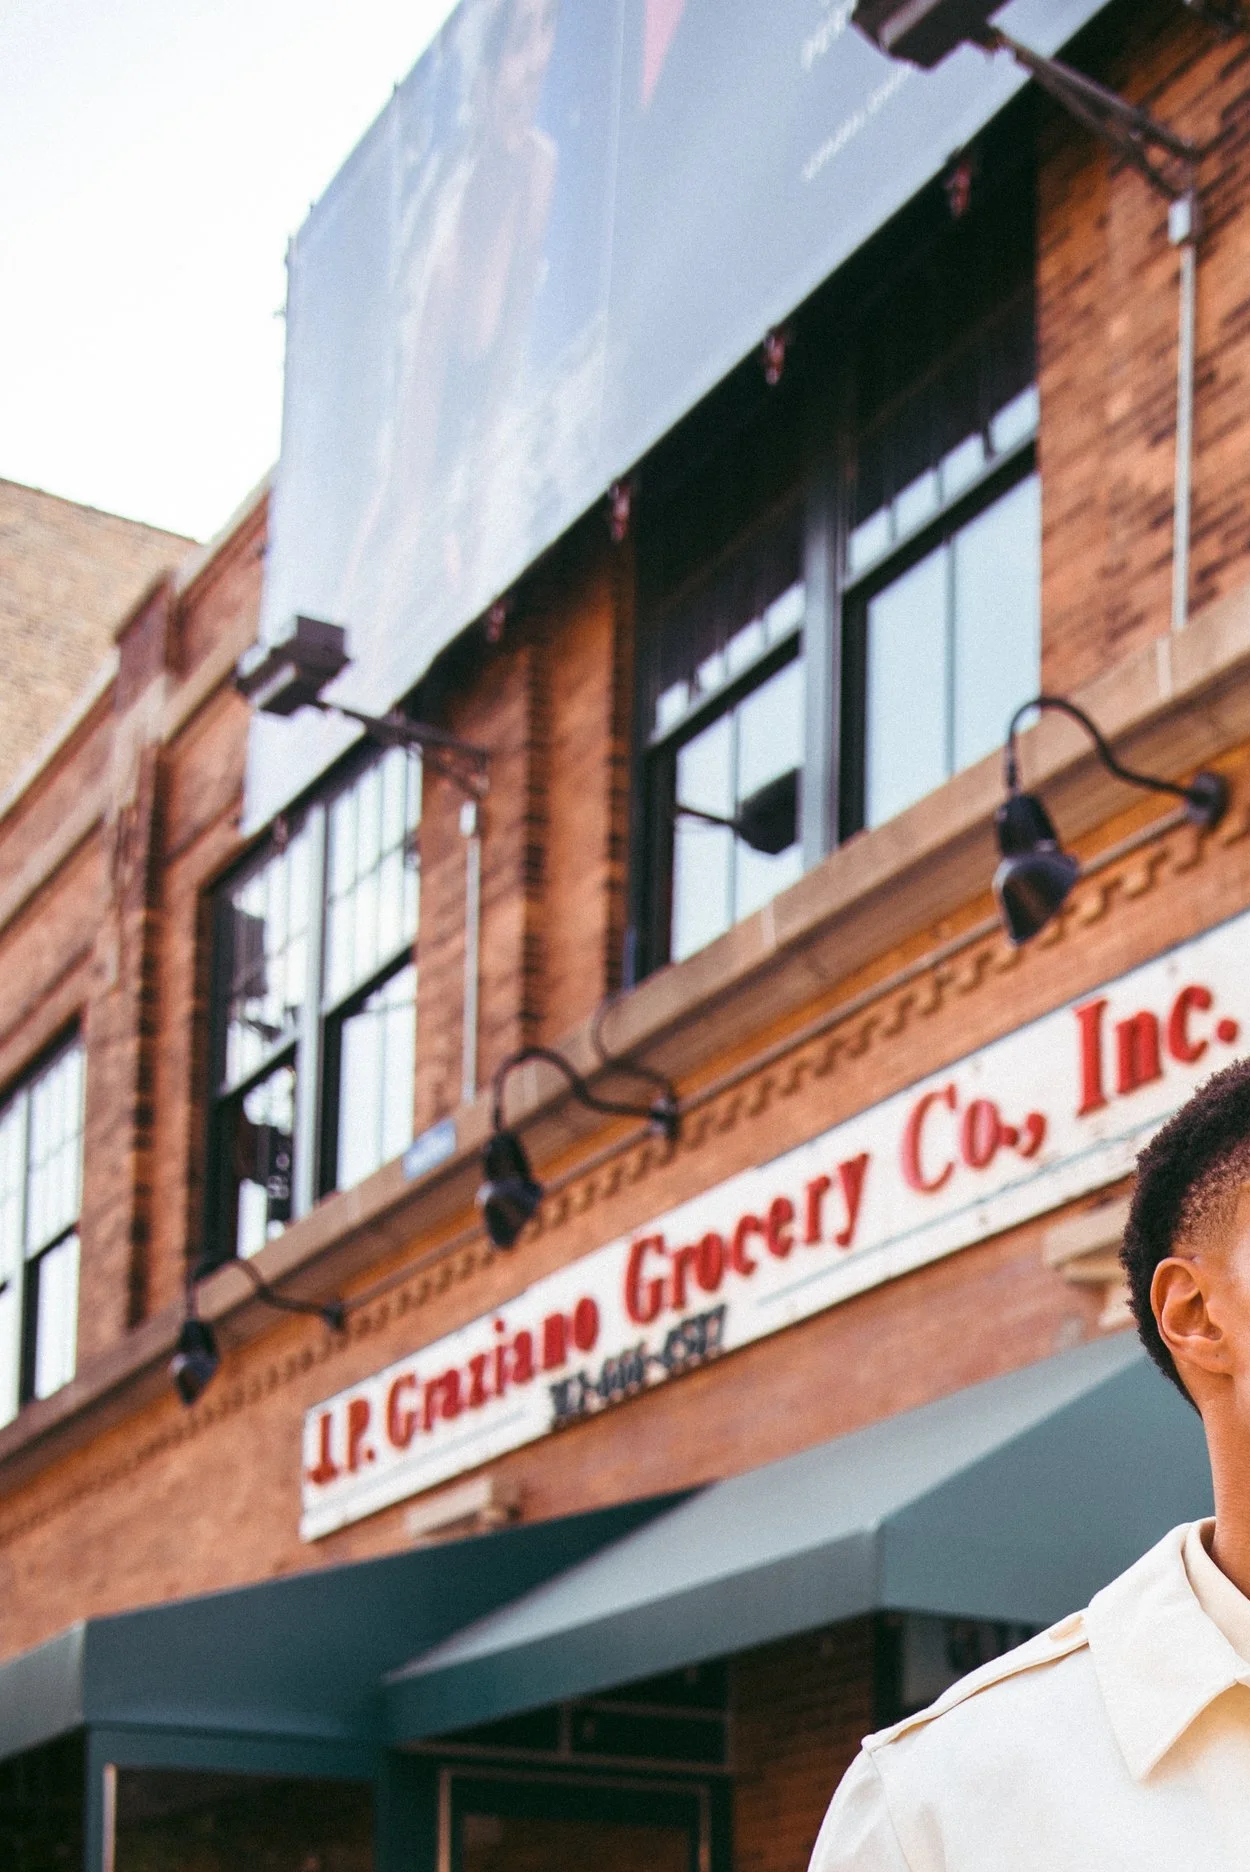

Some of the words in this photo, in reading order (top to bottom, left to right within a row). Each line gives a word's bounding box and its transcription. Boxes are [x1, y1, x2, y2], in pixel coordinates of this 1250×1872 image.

[386, 1294, 600, 1449] Graziano
[624, 1153, 869, 1325] Grocery
[1073, 985, 1240, 1118] Inc.
